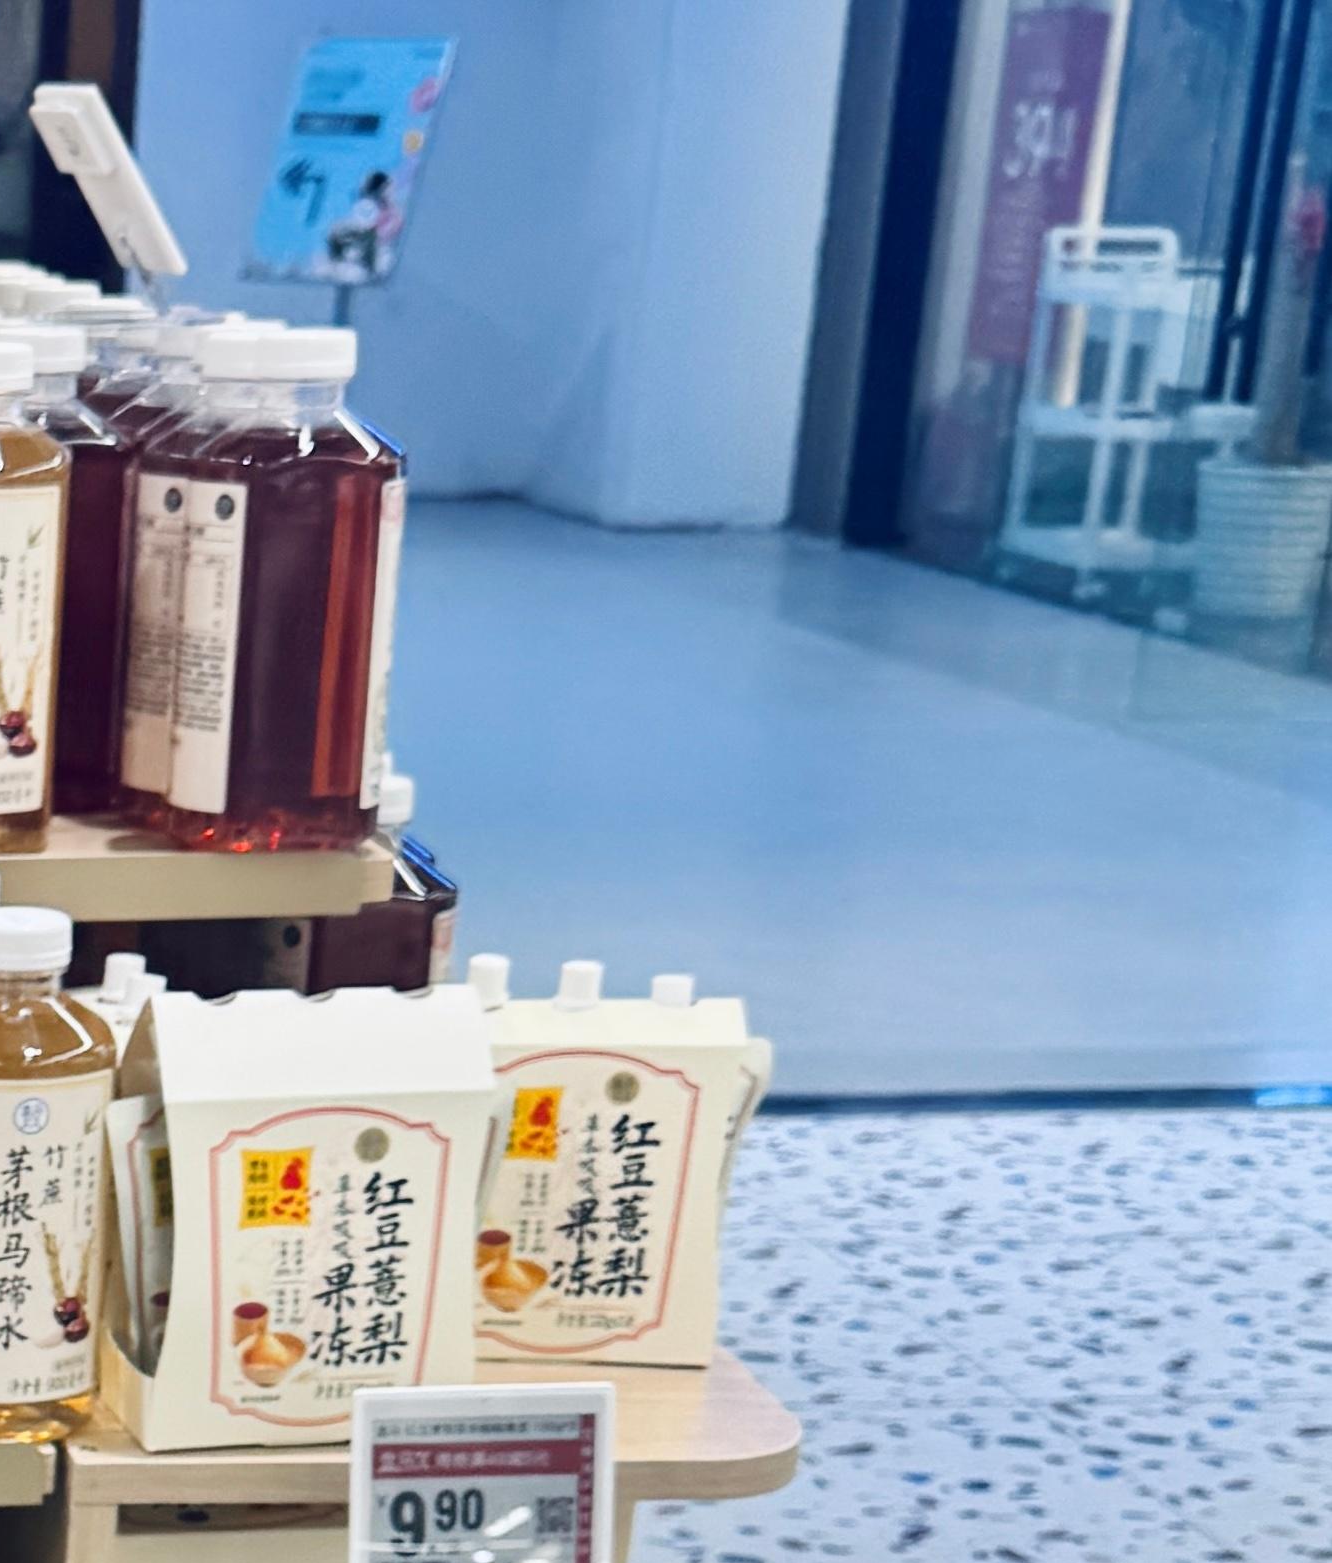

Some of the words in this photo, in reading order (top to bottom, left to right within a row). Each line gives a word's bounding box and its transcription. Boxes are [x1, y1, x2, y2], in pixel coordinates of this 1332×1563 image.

[356, 1172, 414, 1364] 红豆薏梨
[597, 1114, 661, 1297] 红豆薏梨
